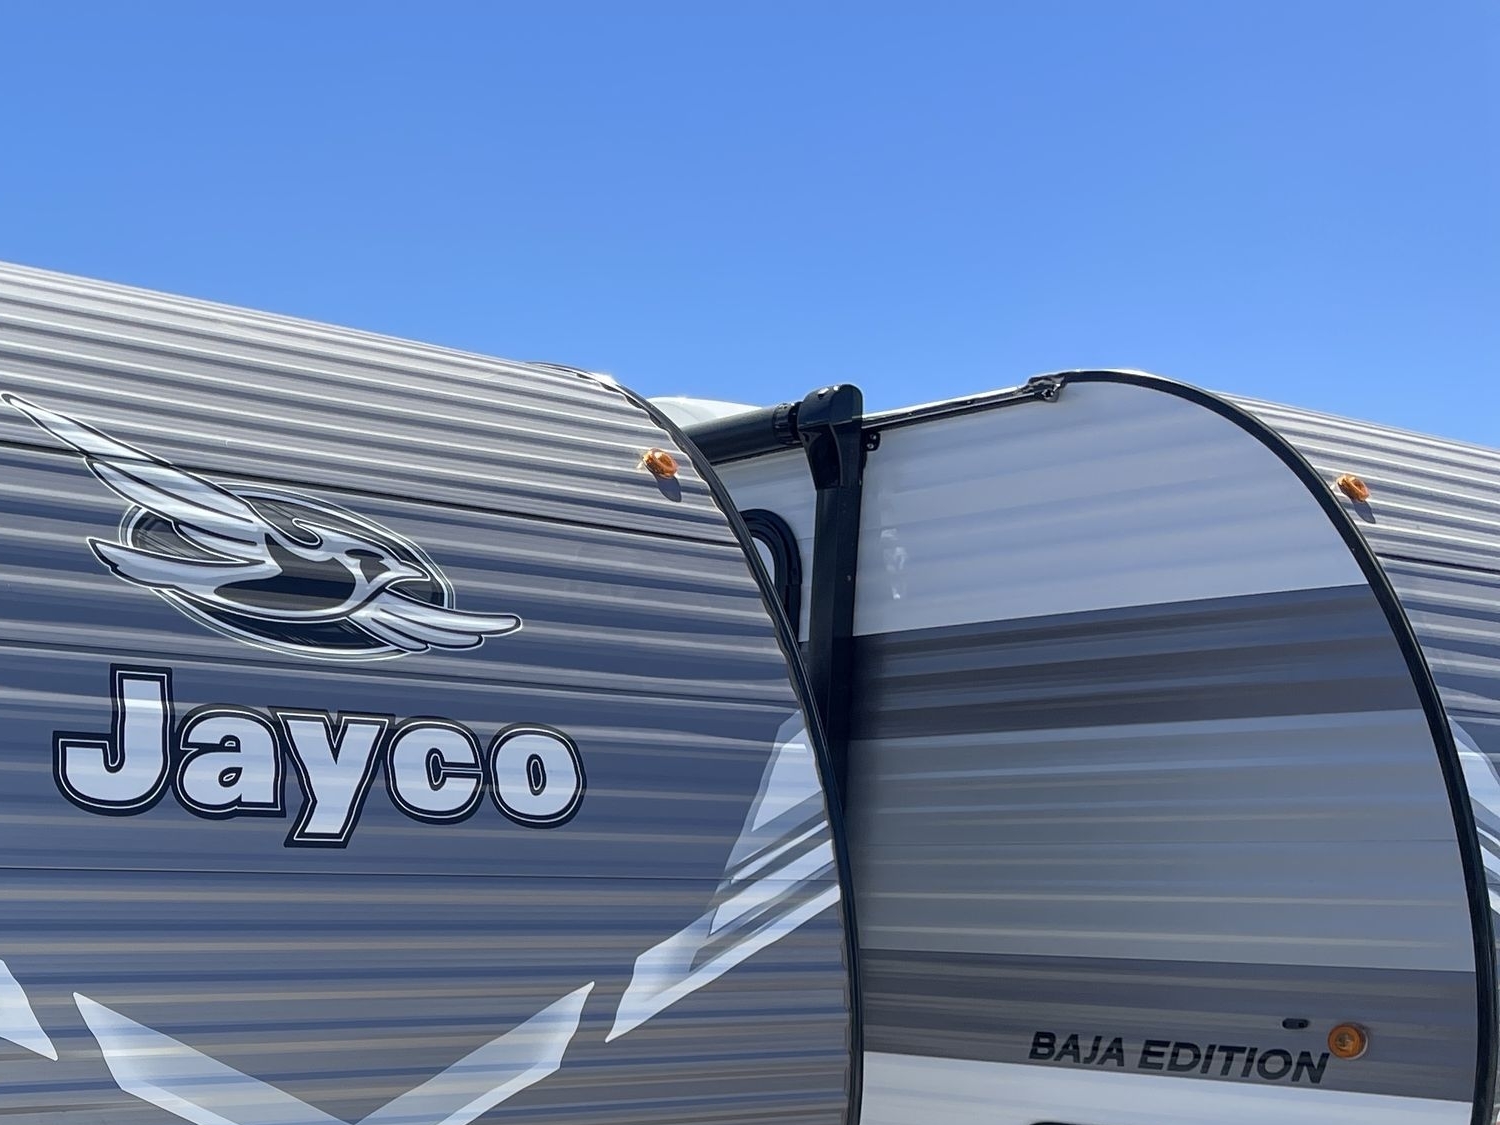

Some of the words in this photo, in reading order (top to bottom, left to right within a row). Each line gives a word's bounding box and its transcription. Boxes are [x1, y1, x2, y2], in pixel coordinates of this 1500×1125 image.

[53, 663, 587, 848] Jayco
[1028, 1031, 1125, 1067] BAJA
[1137, 1040, 1330, 1084] EDITION
